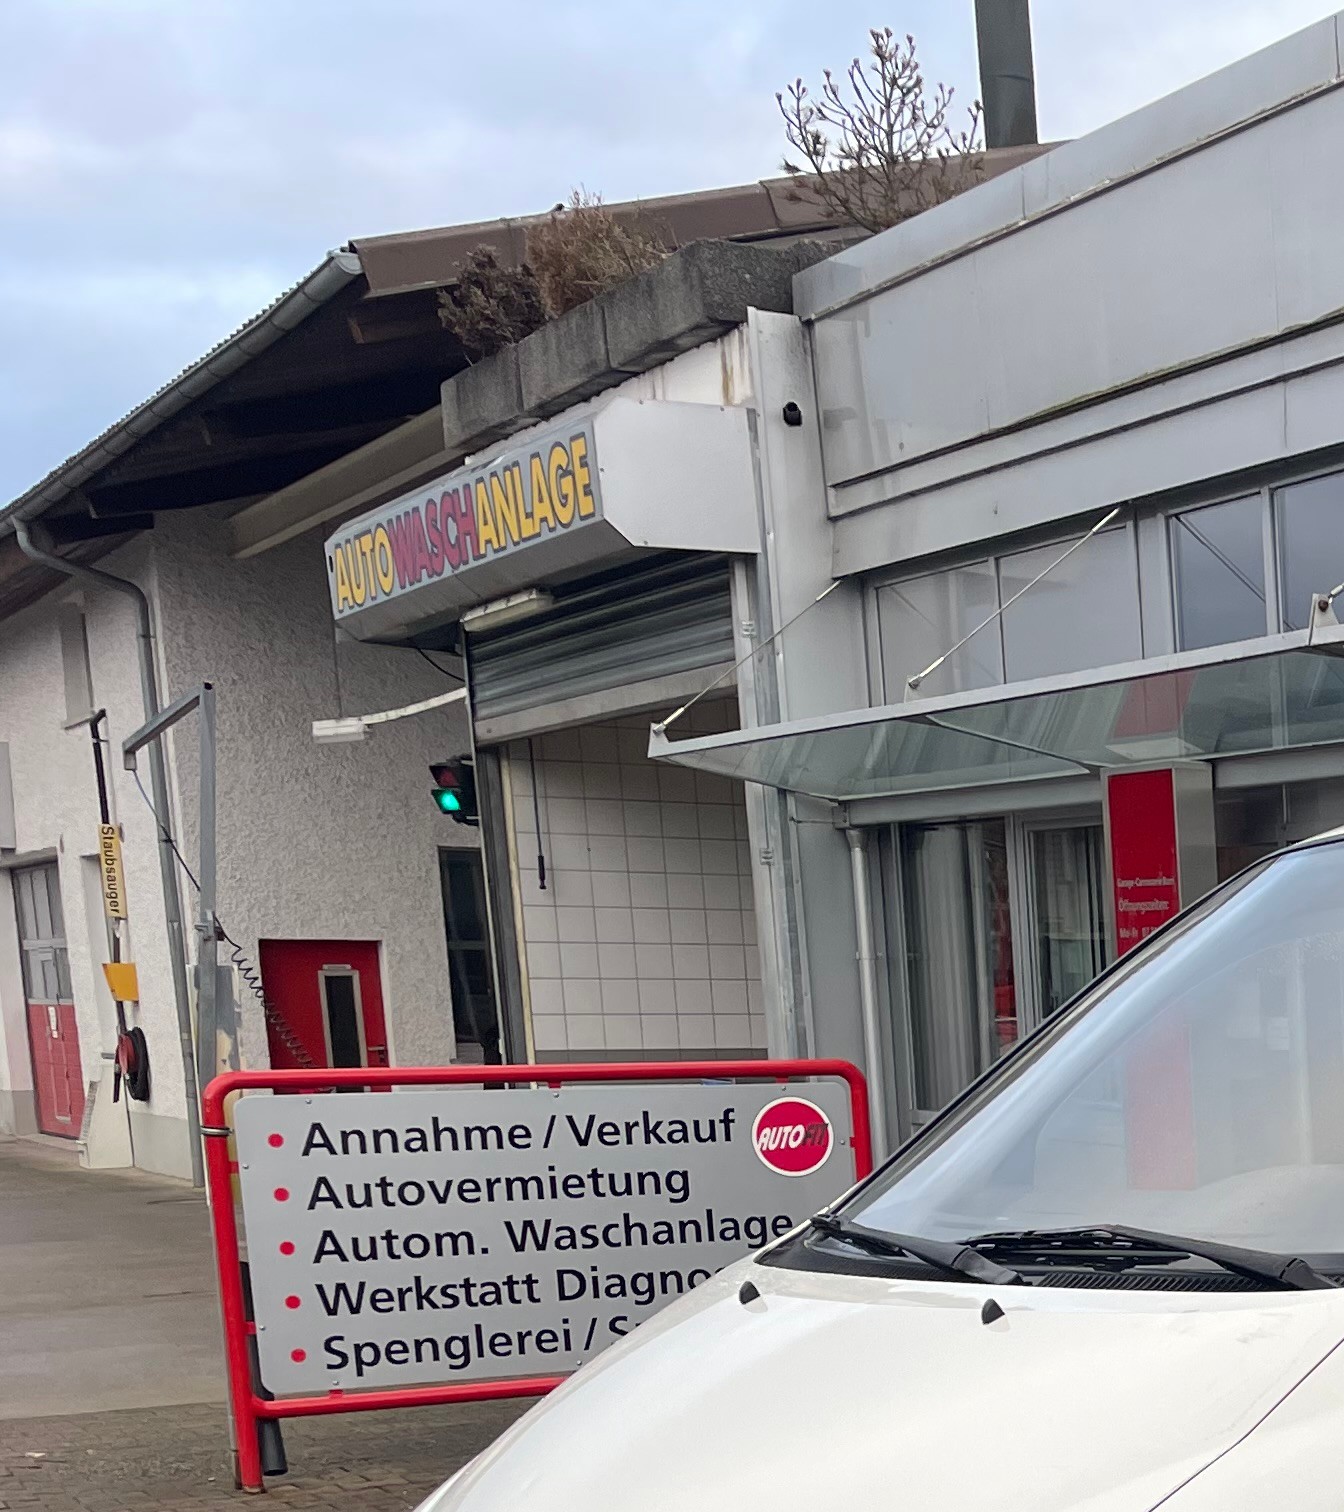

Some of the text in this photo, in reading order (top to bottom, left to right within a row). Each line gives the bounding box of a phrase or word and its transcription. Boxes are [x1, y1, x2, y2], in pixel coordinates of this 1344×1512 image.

[334, 431, 595, 614] AUTOWASCHANLAGE
[101, 826, 120, 914] Staubsauger
[302, 1116, 532, 1157] Annahme
[566, 1108, 736, 1147] Verkauf
[757, 1121, 830, 1152] AUTOFIT
[308, 1165, 690, 1211] Autovermietung
[313, 1209, 795, 1264] Autom. Waschanlage
[315, 1265, 727, 1317] Werkstatt Diagno
[324, 1317, 572, 1378] Spenglerei
